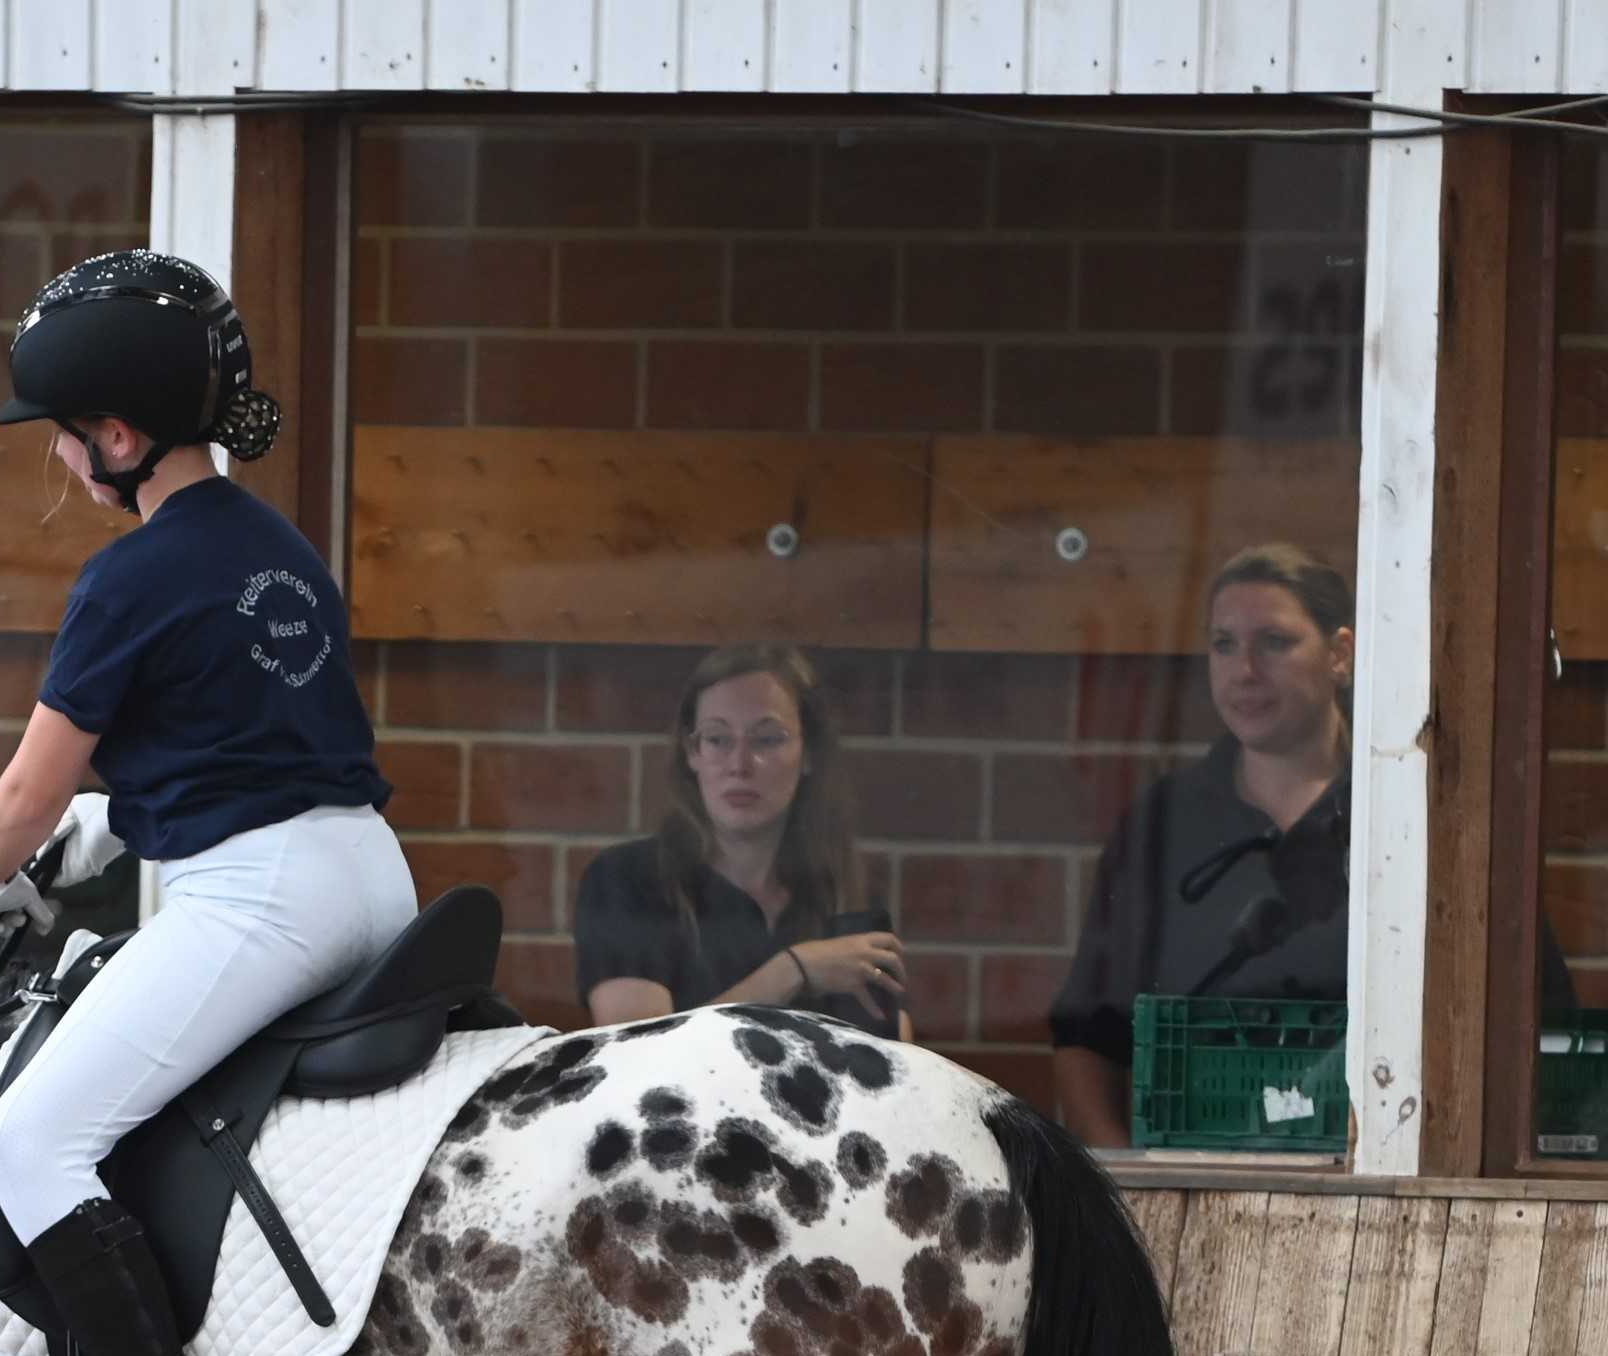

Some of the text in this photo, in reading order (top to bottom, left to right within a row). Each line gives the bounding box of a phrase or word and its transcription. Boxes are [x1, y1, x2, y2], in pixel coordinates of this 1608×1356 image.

[236, 569, 318, 616] Reiterverein
[268, 619, 308, 638] Weeze
[251, 643, 281, 672] Graf
